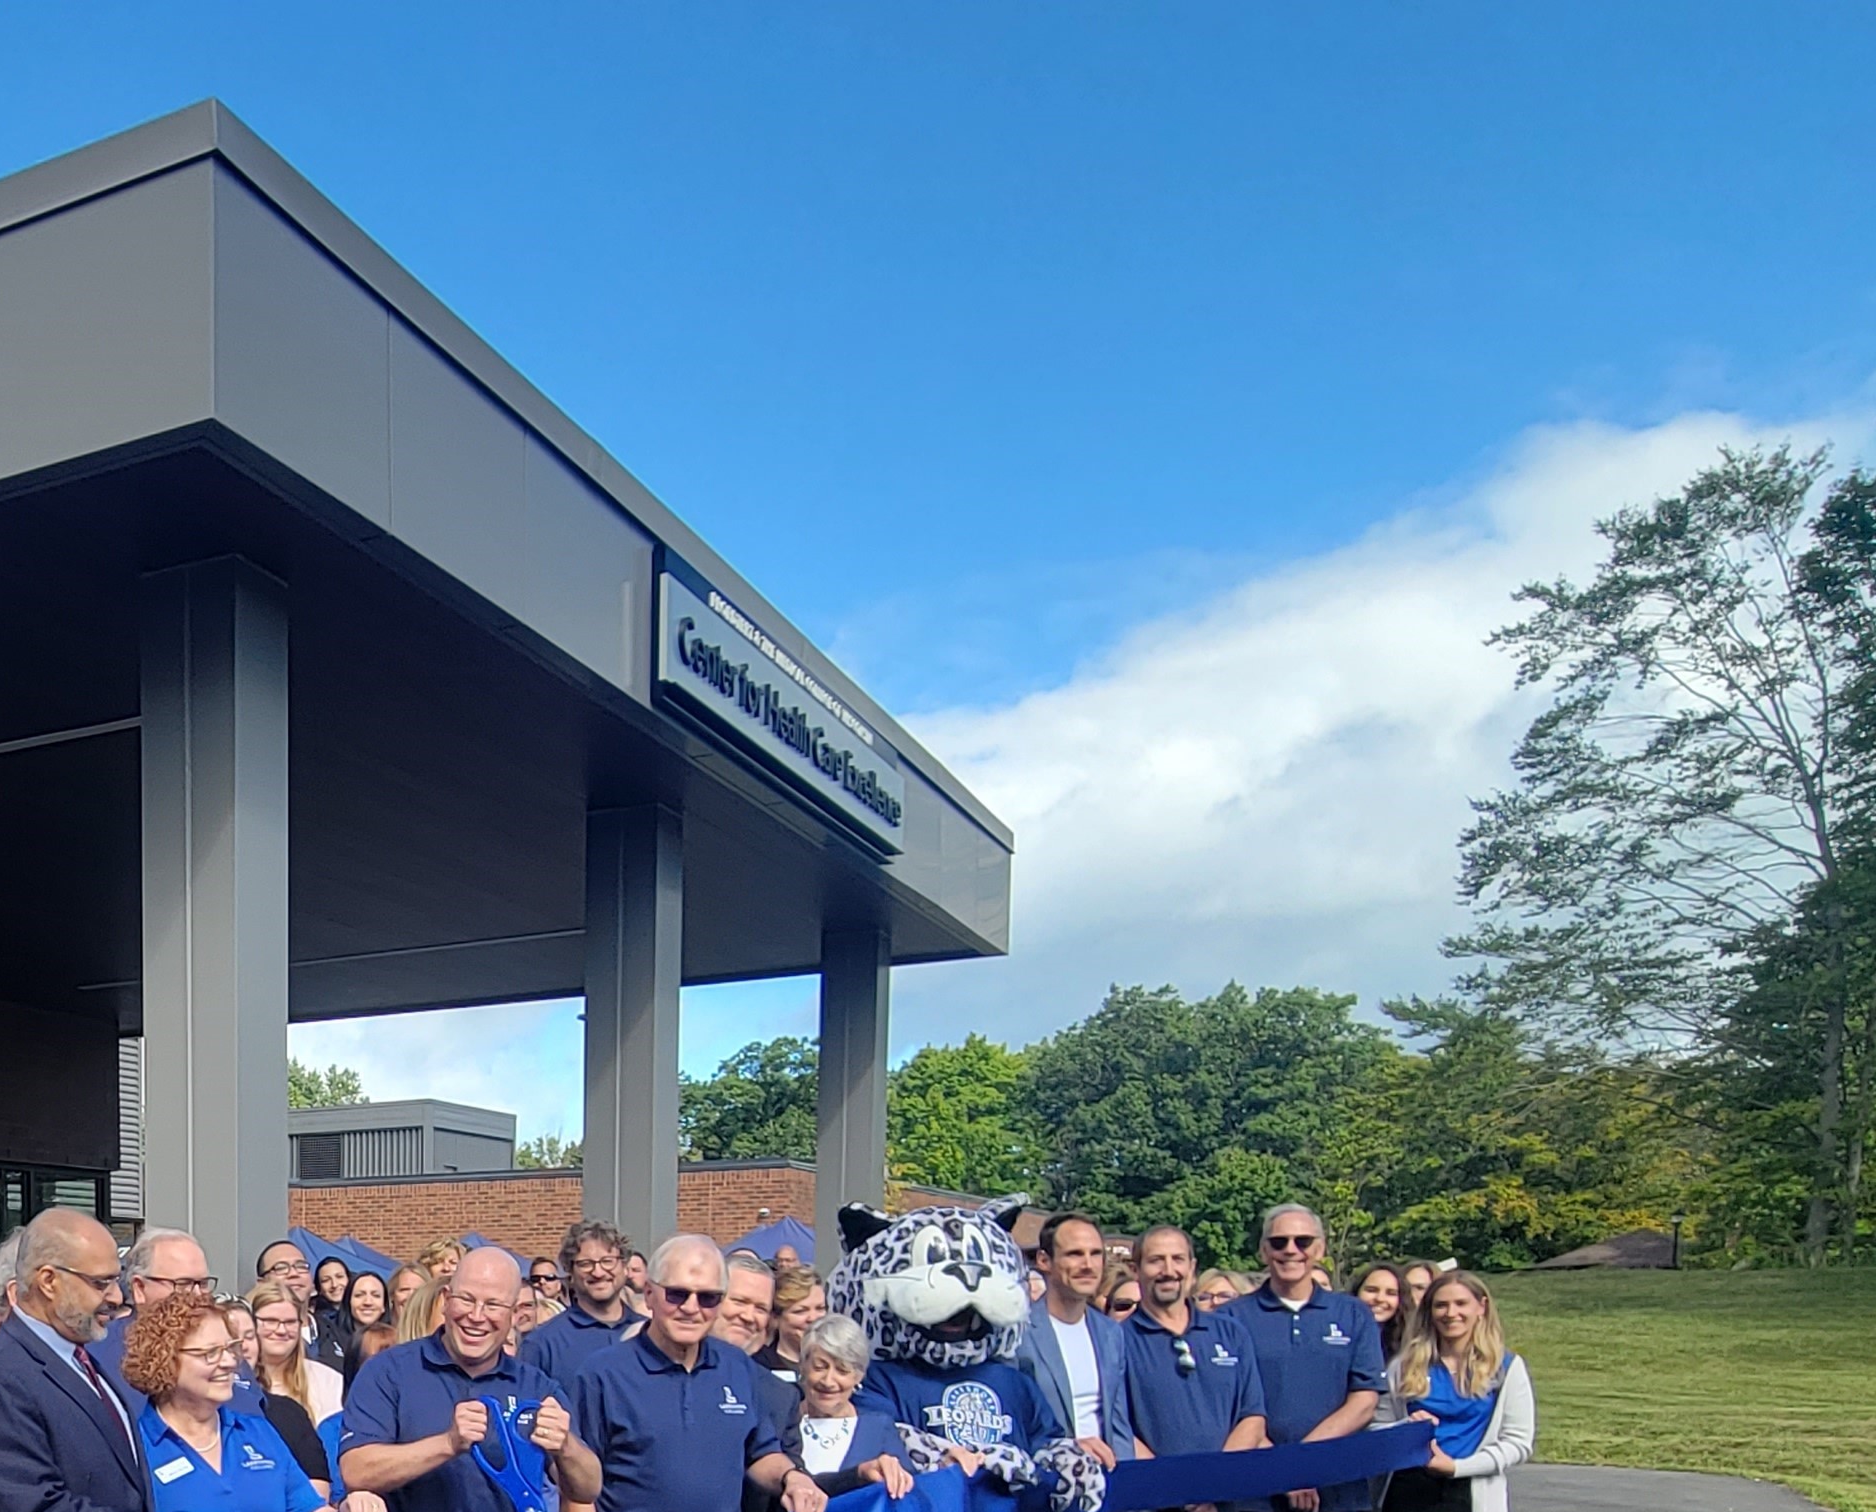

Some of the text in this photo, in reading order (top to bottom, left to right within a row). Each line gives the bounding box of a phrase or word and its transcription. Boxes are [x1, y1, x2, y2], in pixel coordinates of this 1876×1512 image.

[678, 616, 737, 698] Center
[738, 663, 764, 718] for
[764, 684, 810, 758] Health
[812, 727, 843, 781] Care
[842, 750, 902, 828] Excellence
[930, 1407, 1011, 1431] LEOPARDS
